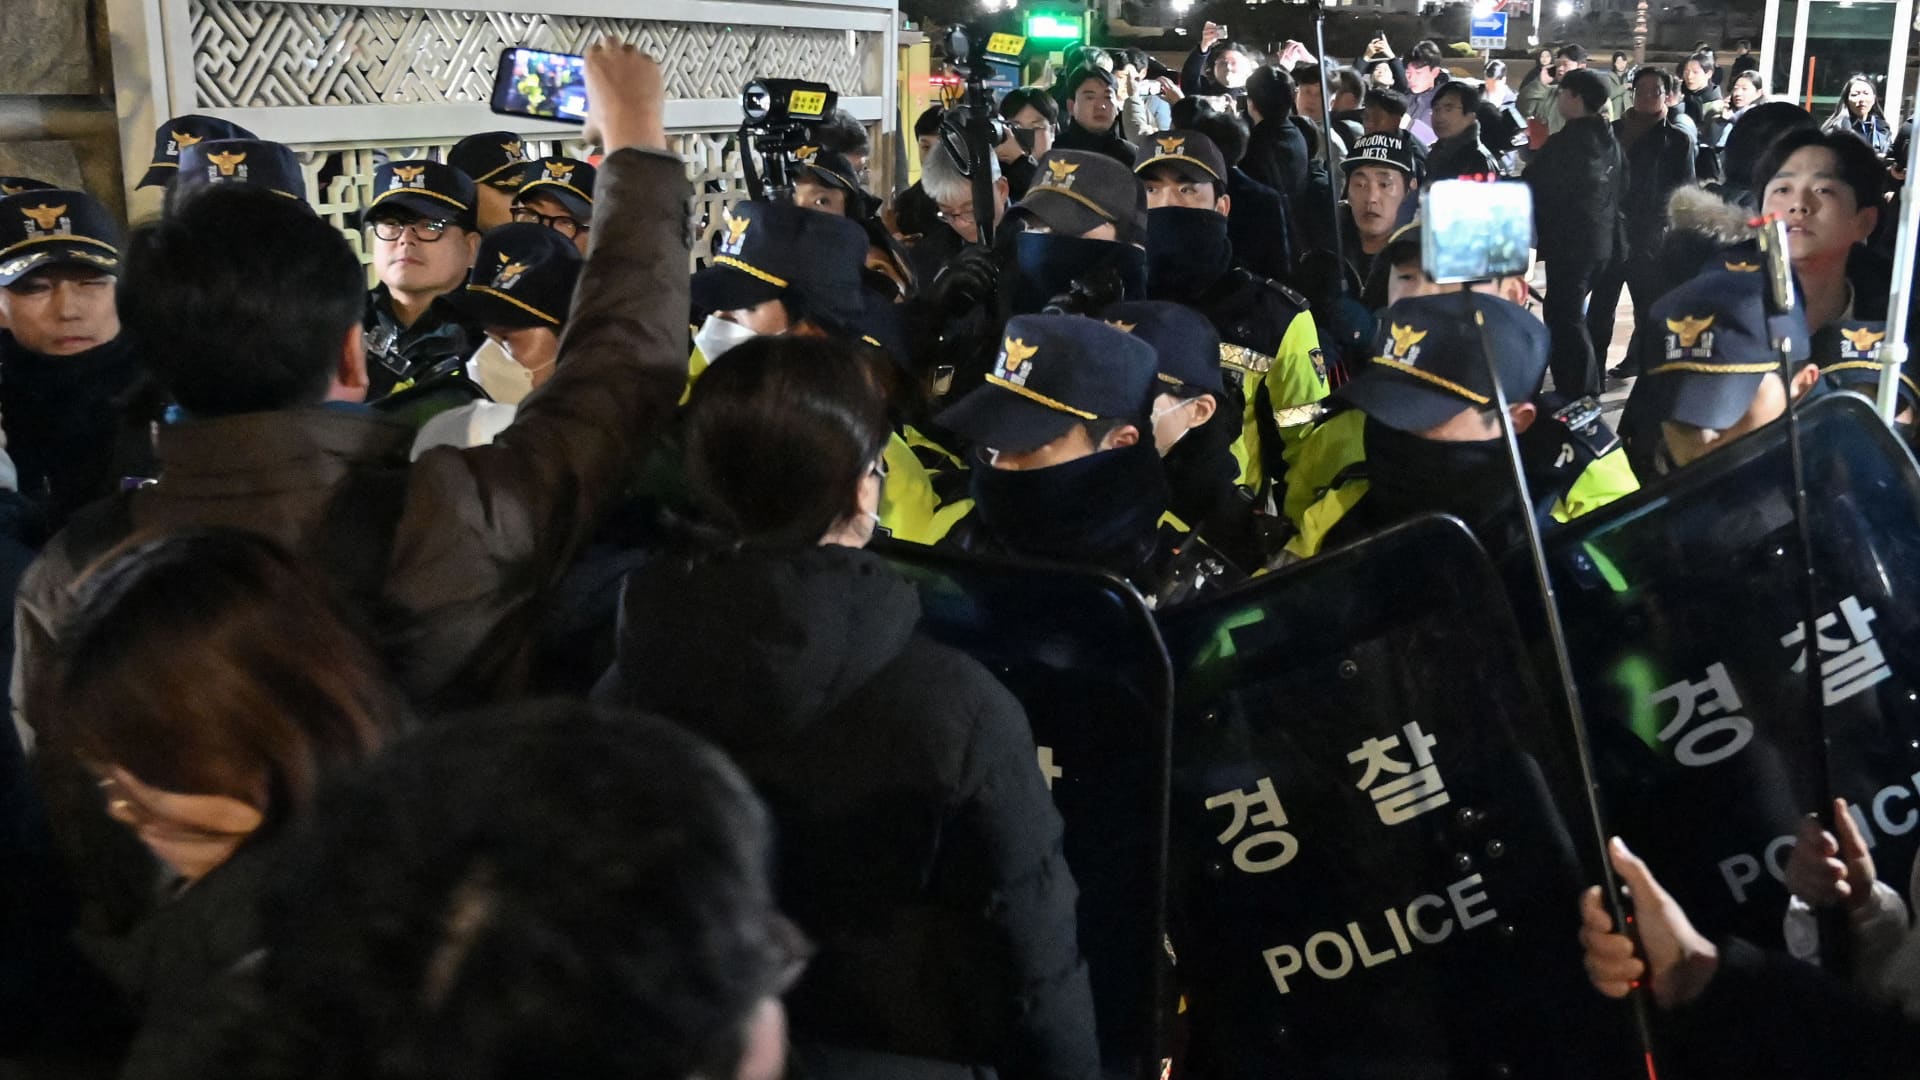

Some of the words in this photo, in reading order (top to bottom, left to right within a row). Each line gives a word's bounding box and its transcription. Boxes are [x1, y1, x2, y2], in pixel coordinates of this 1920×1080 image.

[1354, 135, 1402, 149] BROOKLYN
[1362, 148, 1388, 160] NETS
[1718, 770, 1920, 904] POIC
[1262, 873, 1497, 994] POLICE
